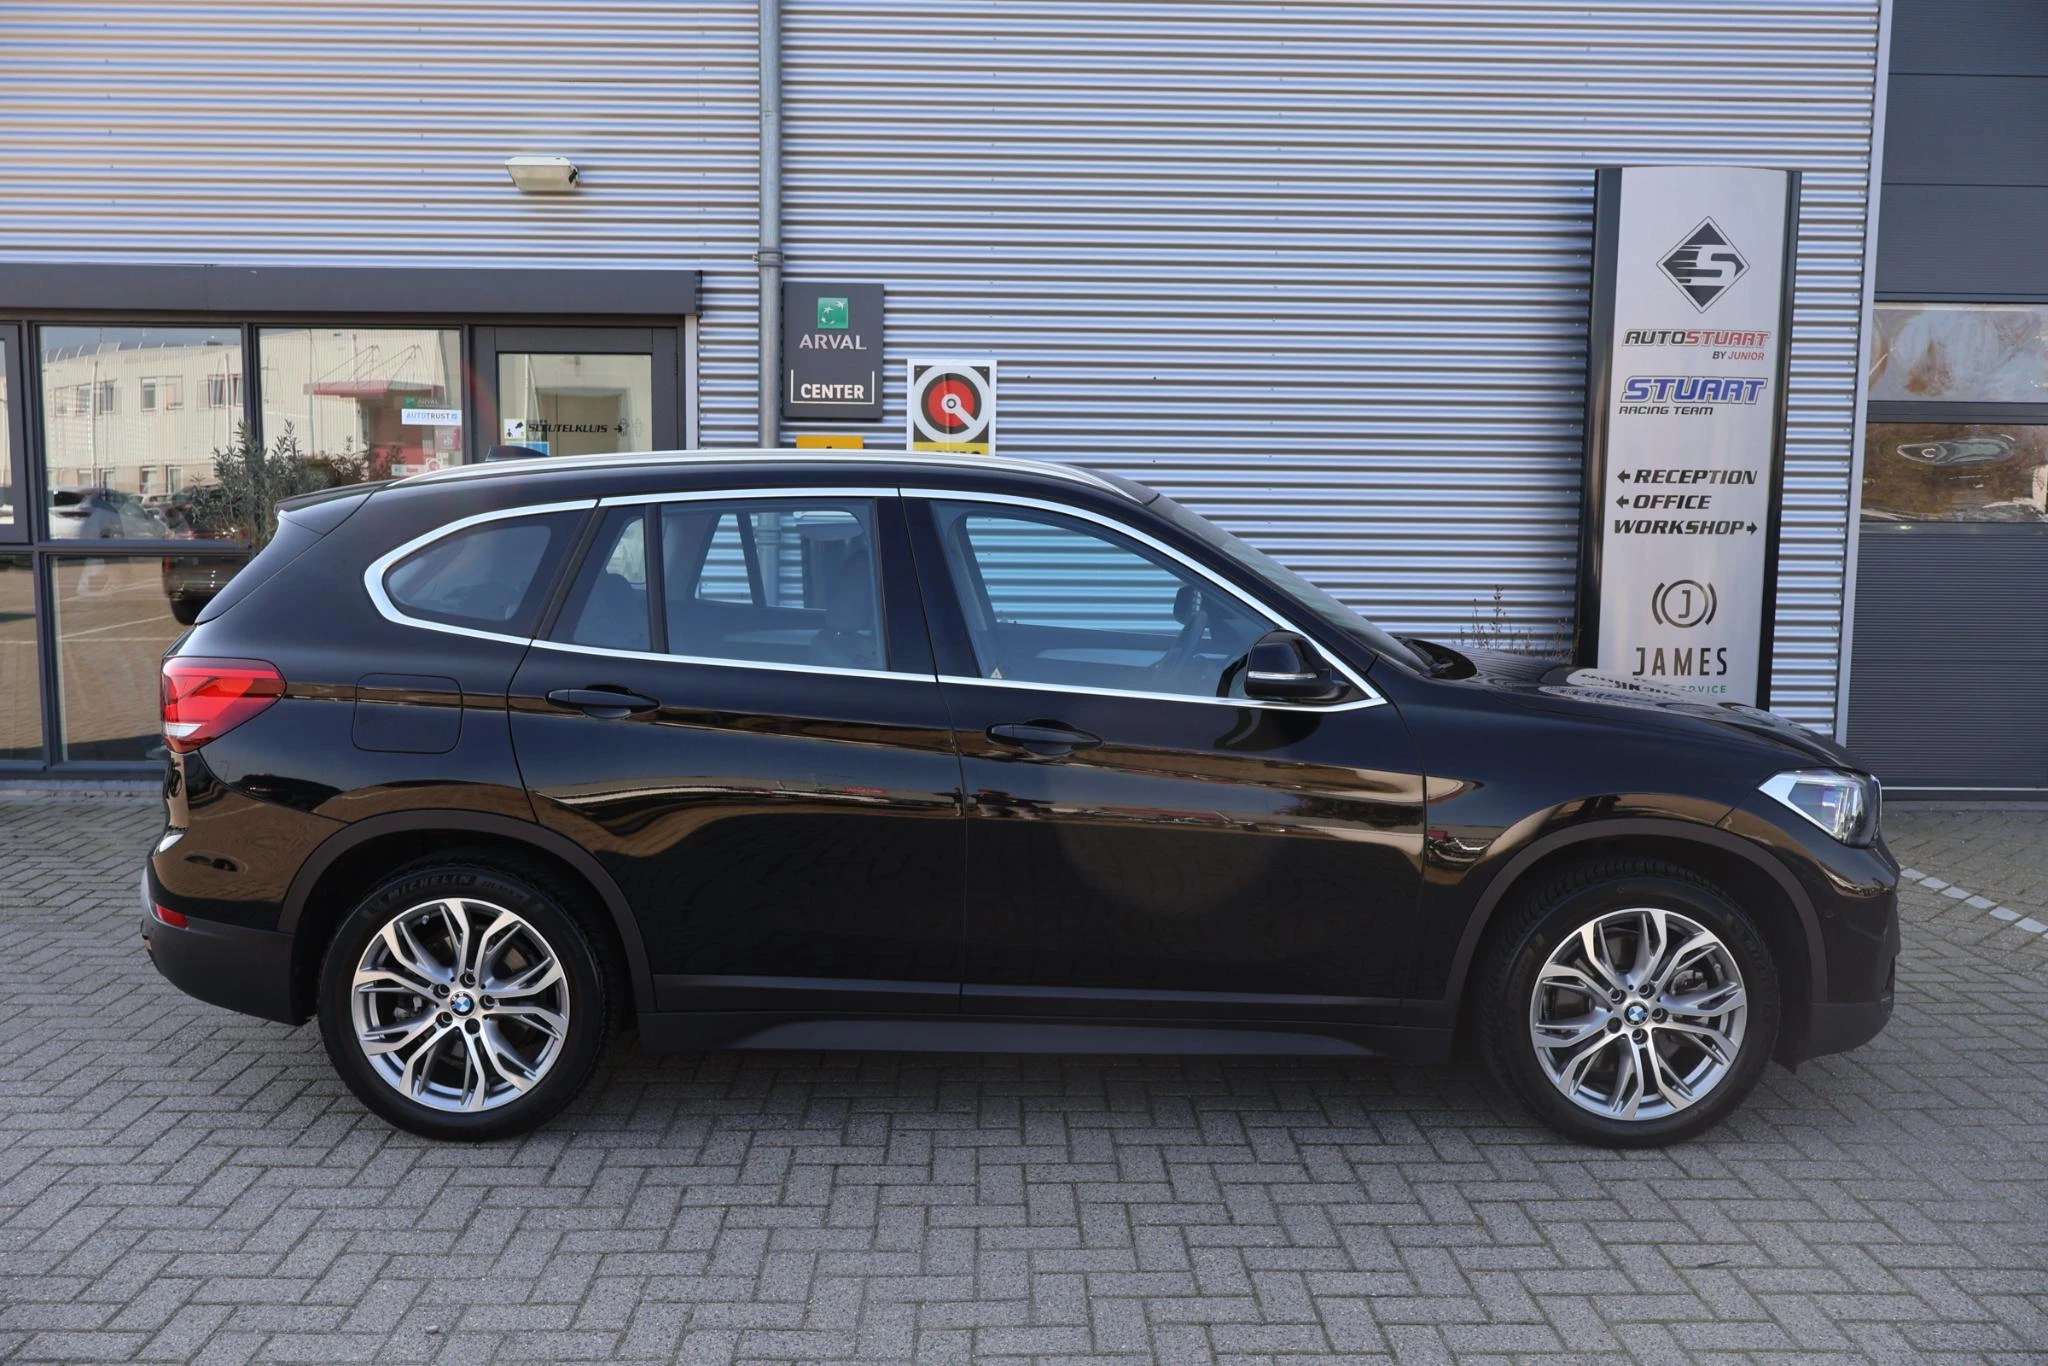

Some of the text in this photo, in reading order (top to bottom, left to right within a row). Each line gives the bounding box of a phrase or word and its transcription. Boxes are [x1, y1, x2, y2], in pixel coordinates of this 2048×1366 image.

[799, 334, 867, 350] ARVAL
[1623, 330, 1770, 348] AUTOSTUART
[1712, 351, 1765, 361] BY JUNIOR
[800, 383, 865, 400] CENTER
[1621, 376, 1768, 404] STUART
[1618, 406, 1714, 416] RACING TEAM
[1633, 469, 1758, 485] RECEPTION
[1632, 494, 1712, 510] OFFICE
[1614, 519, 1745, 535] WORKSHOP
[1632, 647, 1728, 676] JAMES
